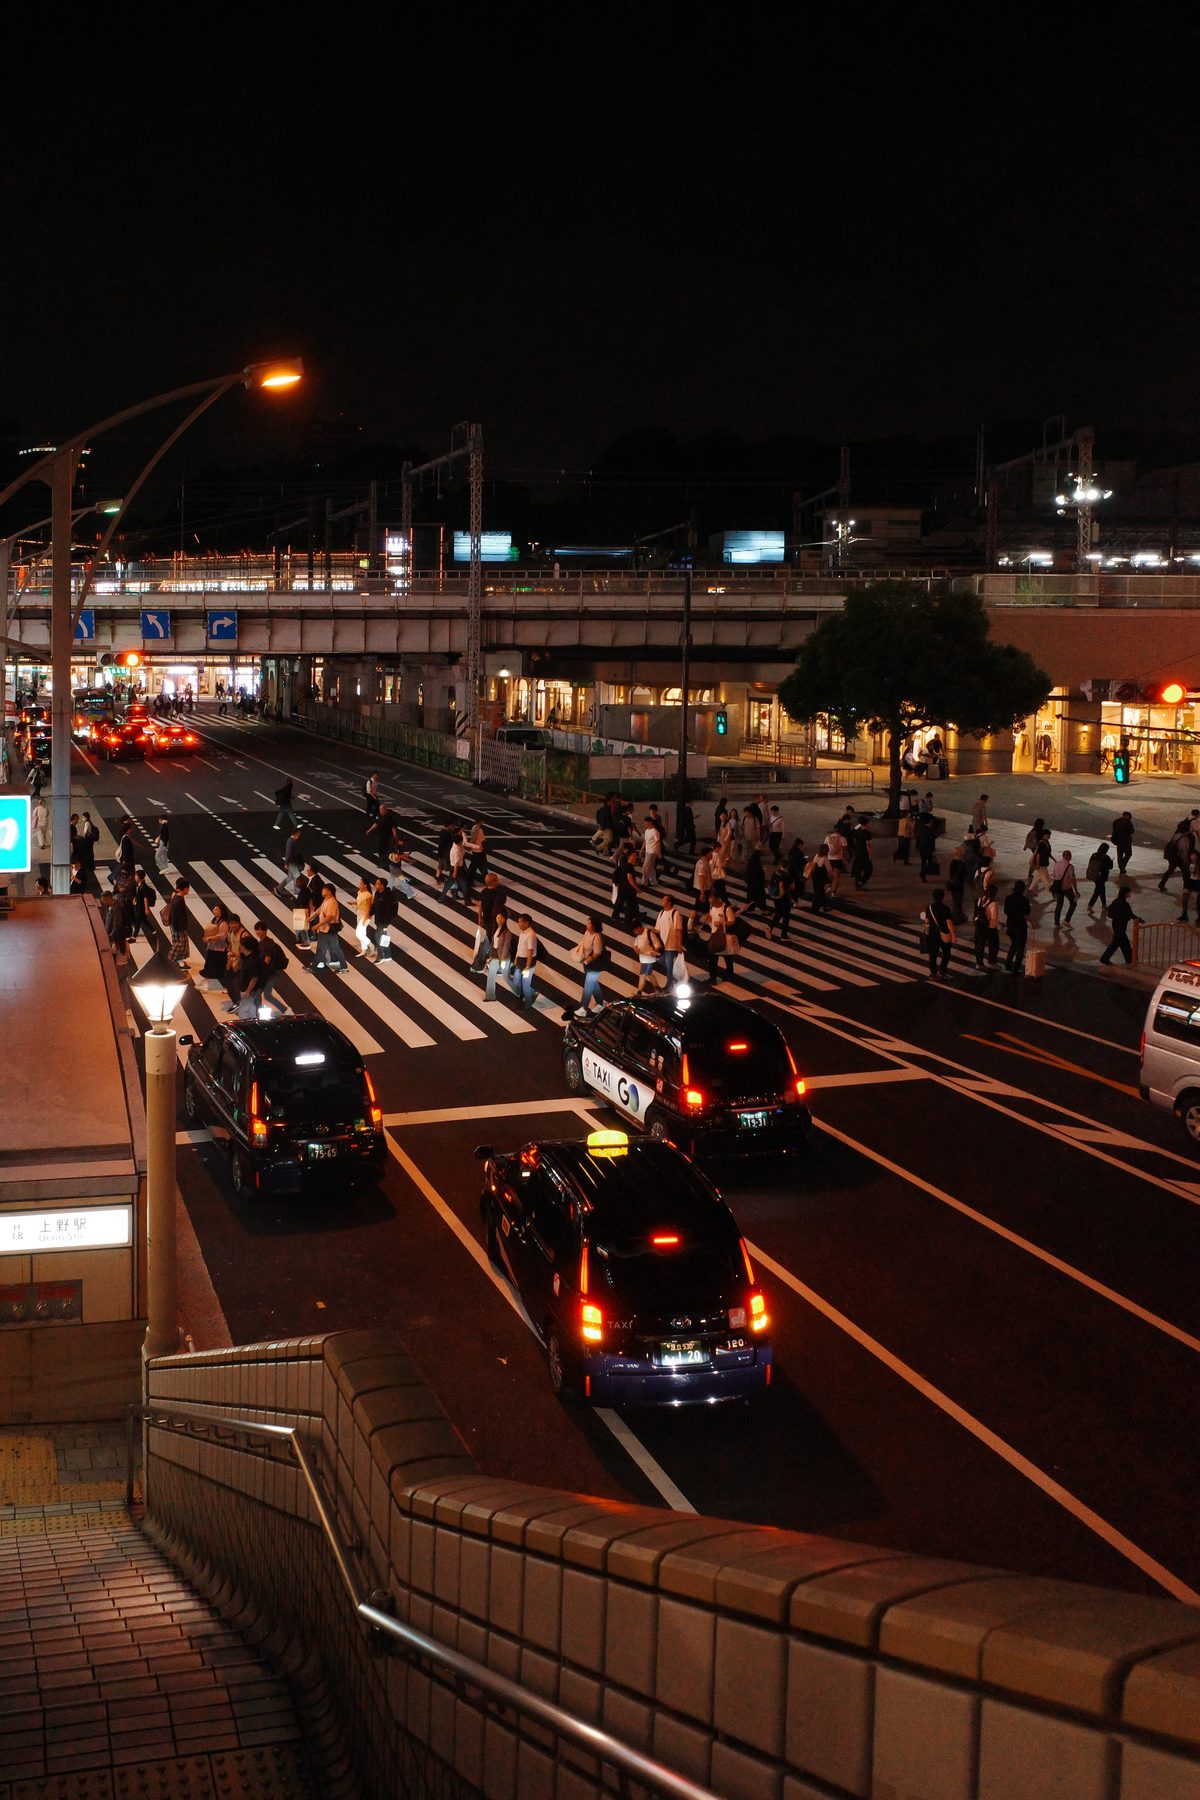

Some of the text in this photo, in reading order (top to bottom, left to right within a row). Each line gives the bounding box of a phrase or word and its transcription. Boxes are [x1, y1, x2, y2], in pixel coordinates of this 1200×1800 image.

[593, 1061, 611, 1089] TAXI
[617, 1077, 640, 1113] GO
[39, 1217, 88, 1233] 上野駅
